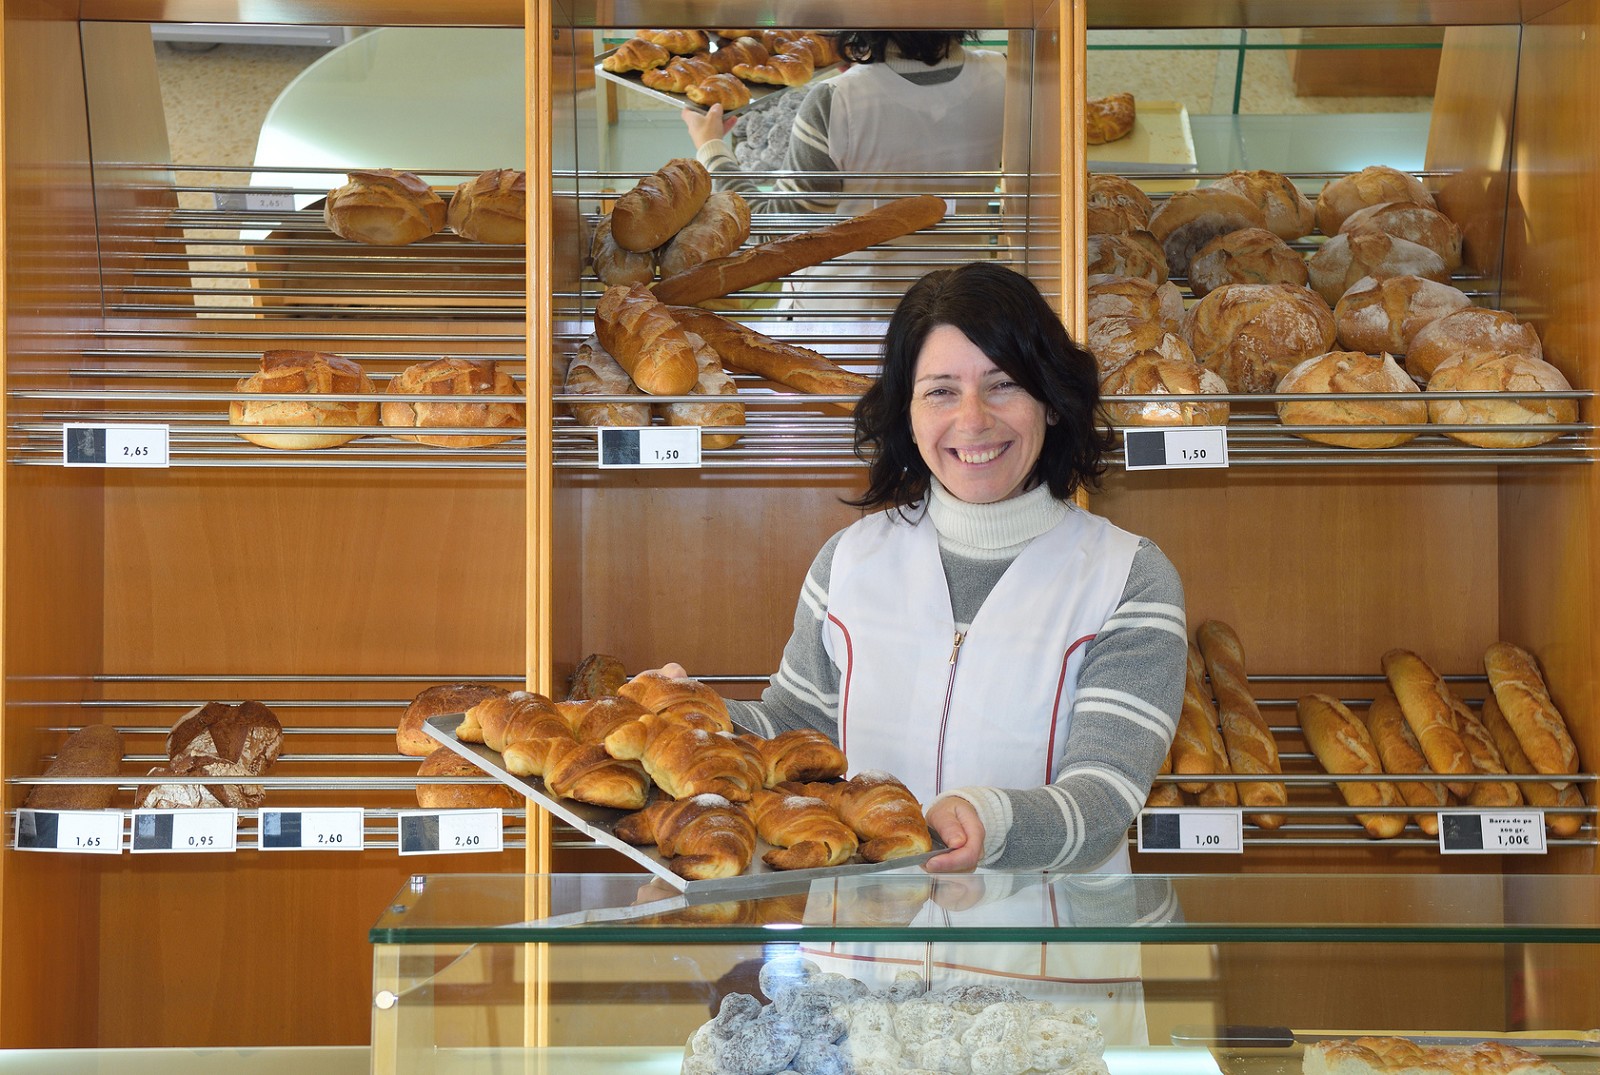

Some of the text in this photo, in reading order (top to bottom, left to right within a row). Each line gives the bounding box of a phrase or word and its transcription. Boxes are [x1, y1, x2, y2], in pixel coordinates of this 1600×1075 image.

[123, 446, 149, 458] 2,65
[654, 449, 680, 461] 1,50
[1182, 449, 1207, 461] 1,50
[76, 836, 101, 848] 1,65
[188, 835, 214, 848] 0,95
[317, 833, 343, 845] 2,60
[454, 835, 480, 847] 2,60
[1195, 834, 1220, 846] 1,00
[1497, 835, 1530, 847] 1,00€
